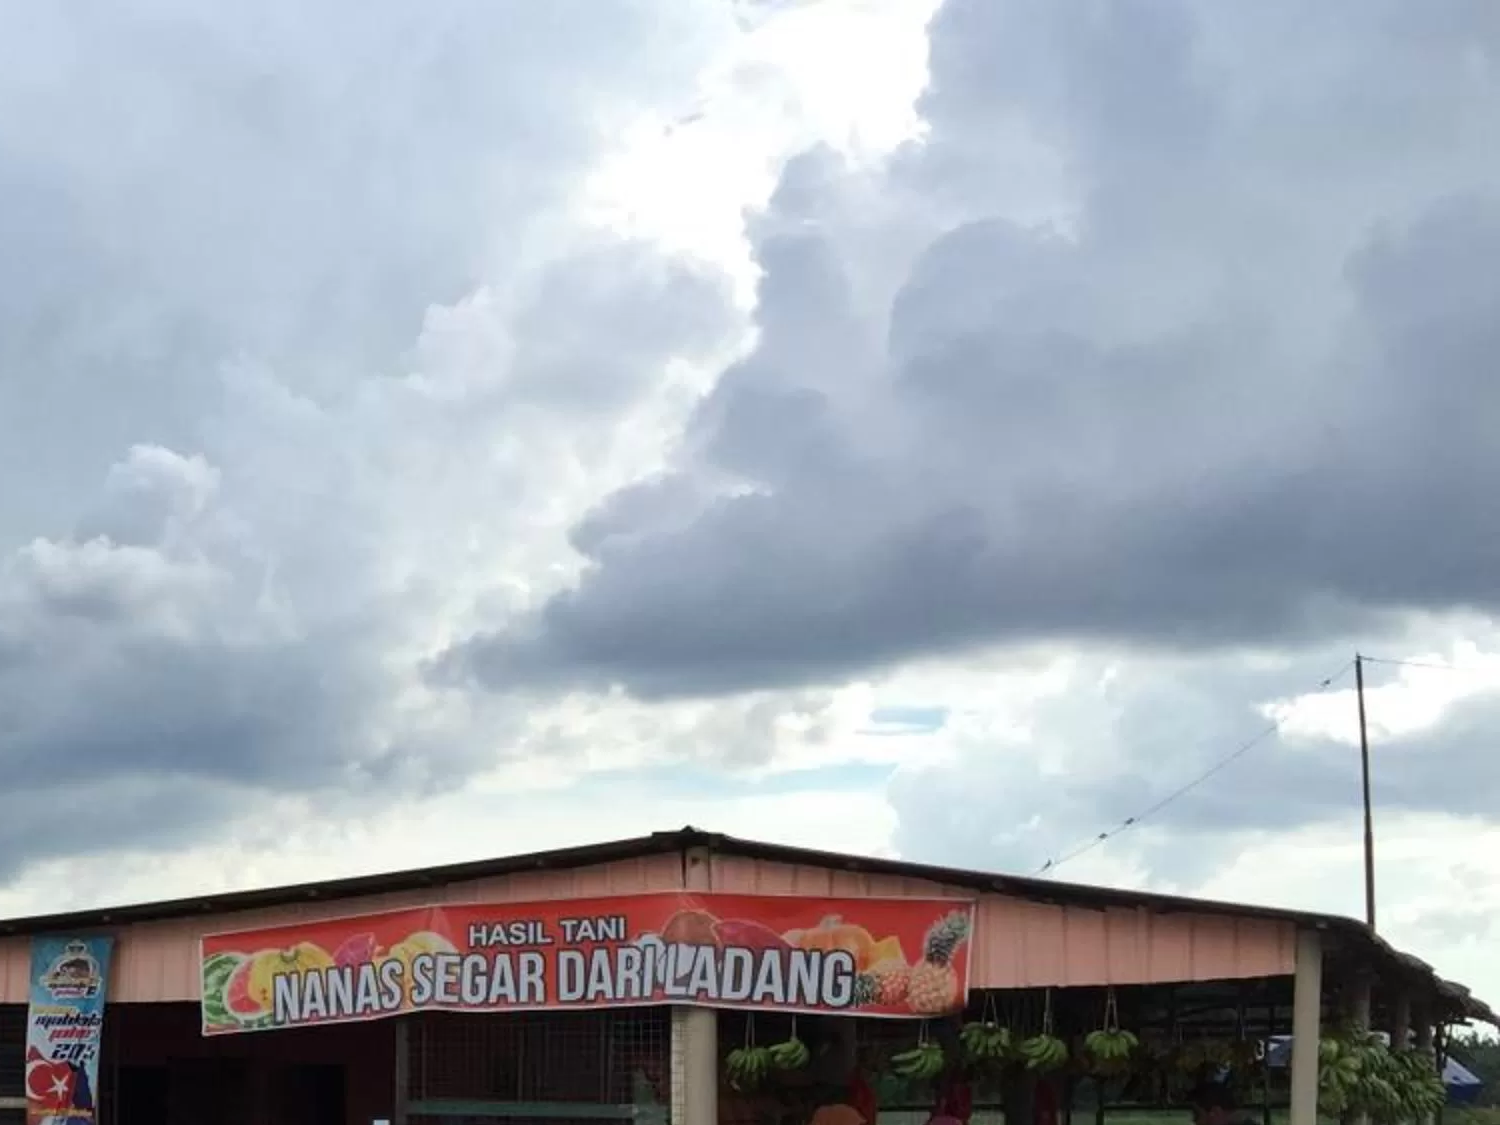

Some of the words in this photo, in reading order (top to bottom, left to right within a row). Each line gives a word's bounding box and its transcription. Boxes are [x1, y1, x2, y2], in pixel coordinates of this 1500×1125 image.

[468, 921, 552, 948] HASIL
[560, 916, 627, 942] TANI
[273, 957, 404, 1025] NANAS
[411, 949, 546, 1006] SEGAR
[557, 946, 653, 1001] DARI
[664, 945, 855, 1008] LADANG
